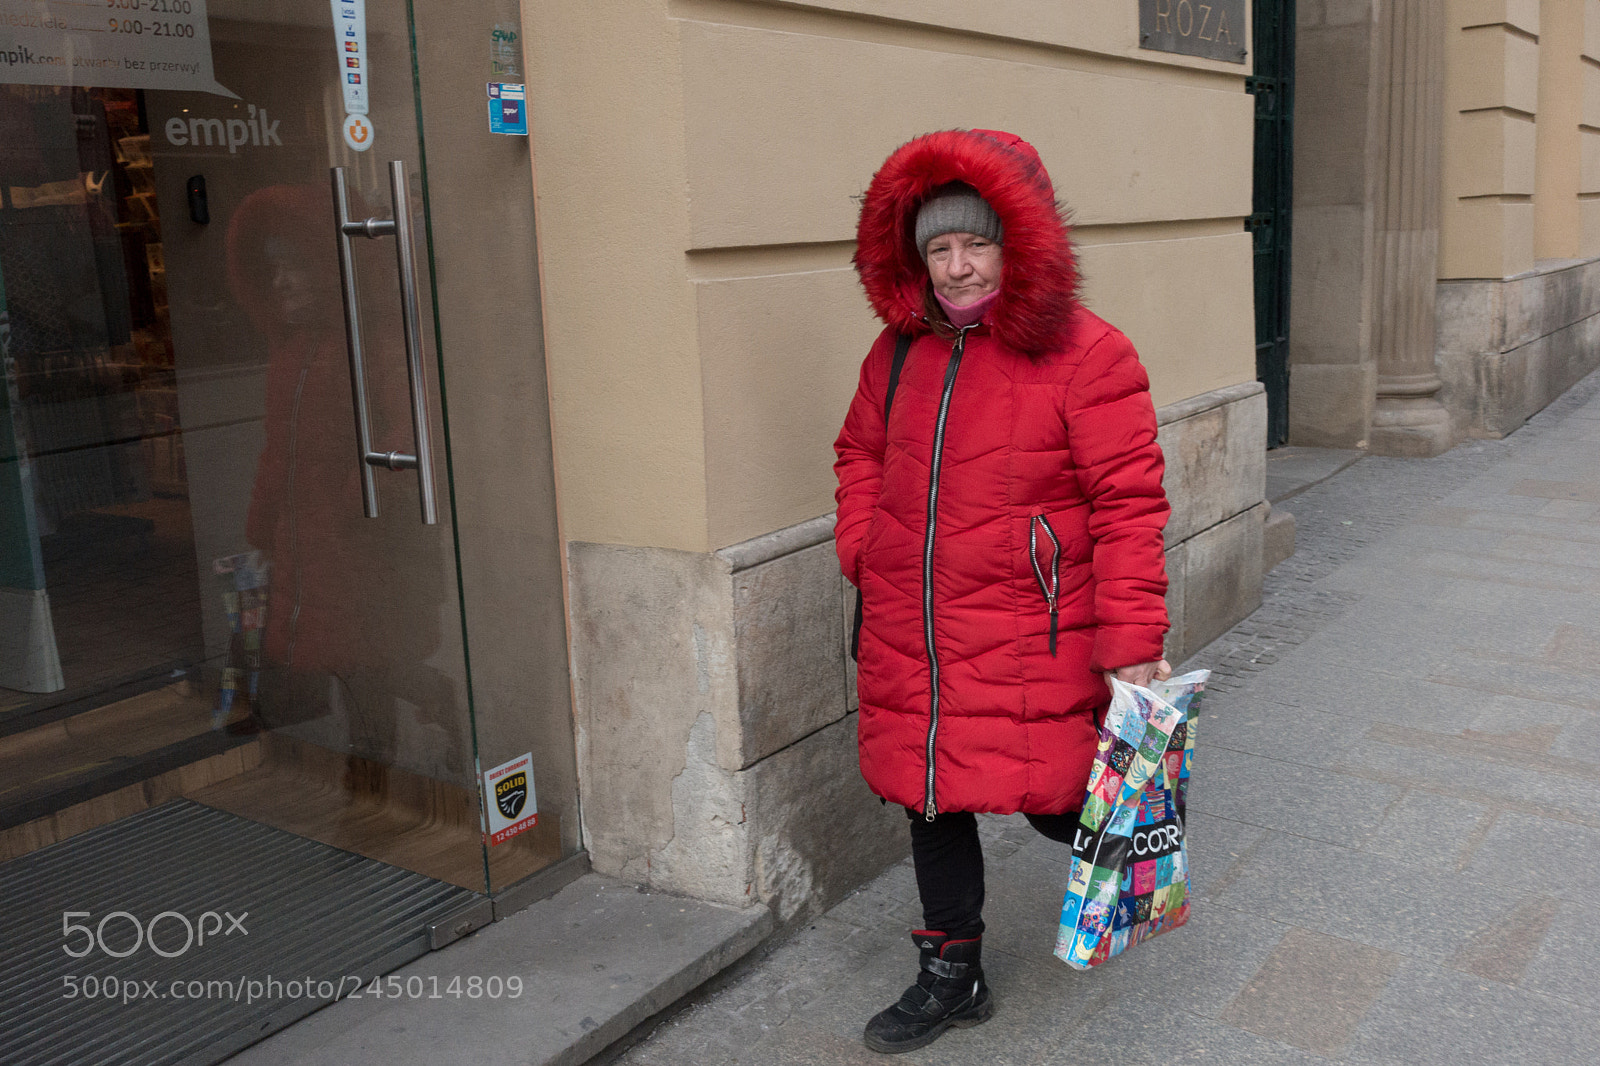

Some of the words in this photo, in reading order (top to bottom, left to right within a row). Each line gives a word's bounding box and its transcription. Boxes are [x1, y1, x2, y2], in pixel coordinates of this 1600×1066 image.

[108, 18, 195, 39] 9.00-21.00
[124, 57, 145, 70] bez
[165, 104, 284, 154] empik
[497, 776, 525, 796] SOLID
[496, 832, 505, 842] 12
